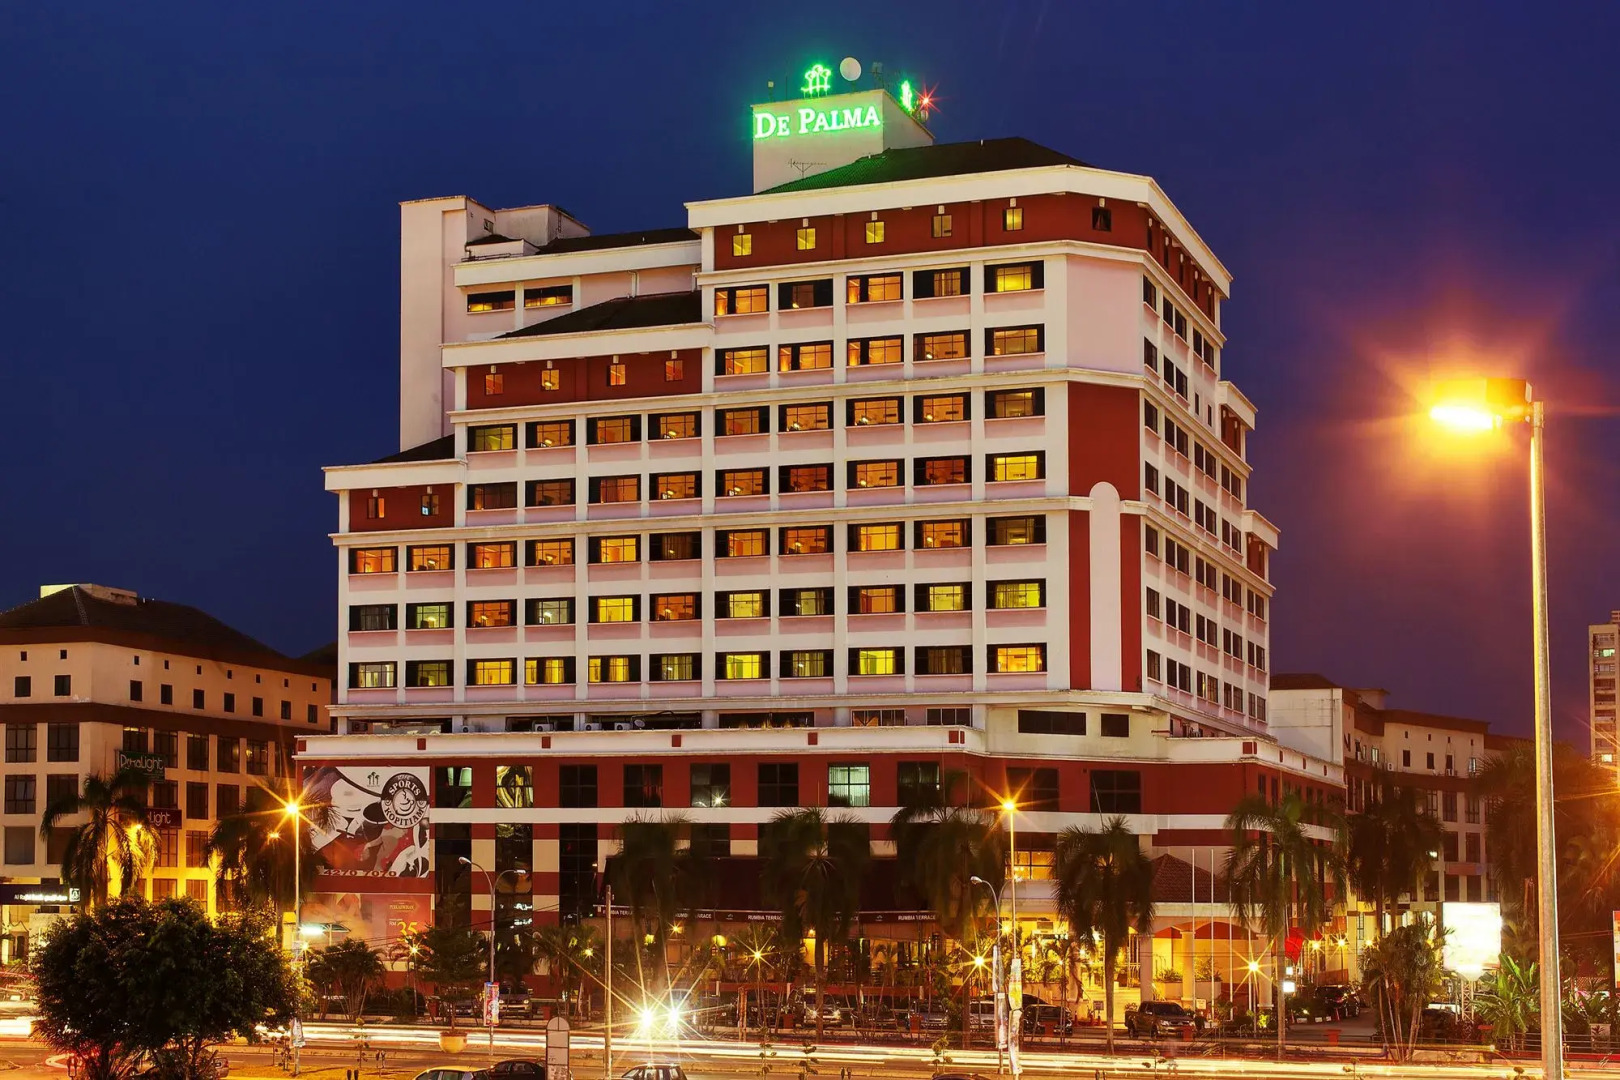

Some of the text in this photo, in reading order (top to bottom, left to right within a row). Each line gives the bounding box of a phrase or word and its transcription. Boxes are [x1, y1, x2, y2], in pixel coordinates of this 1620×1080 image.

[754, 106, 881, 138] DE PALMA
[388, 780, 421, 796] SPORTS
[149, 812, 171, 826] Light
[384, 808, 426, 826] KOPITIAM
